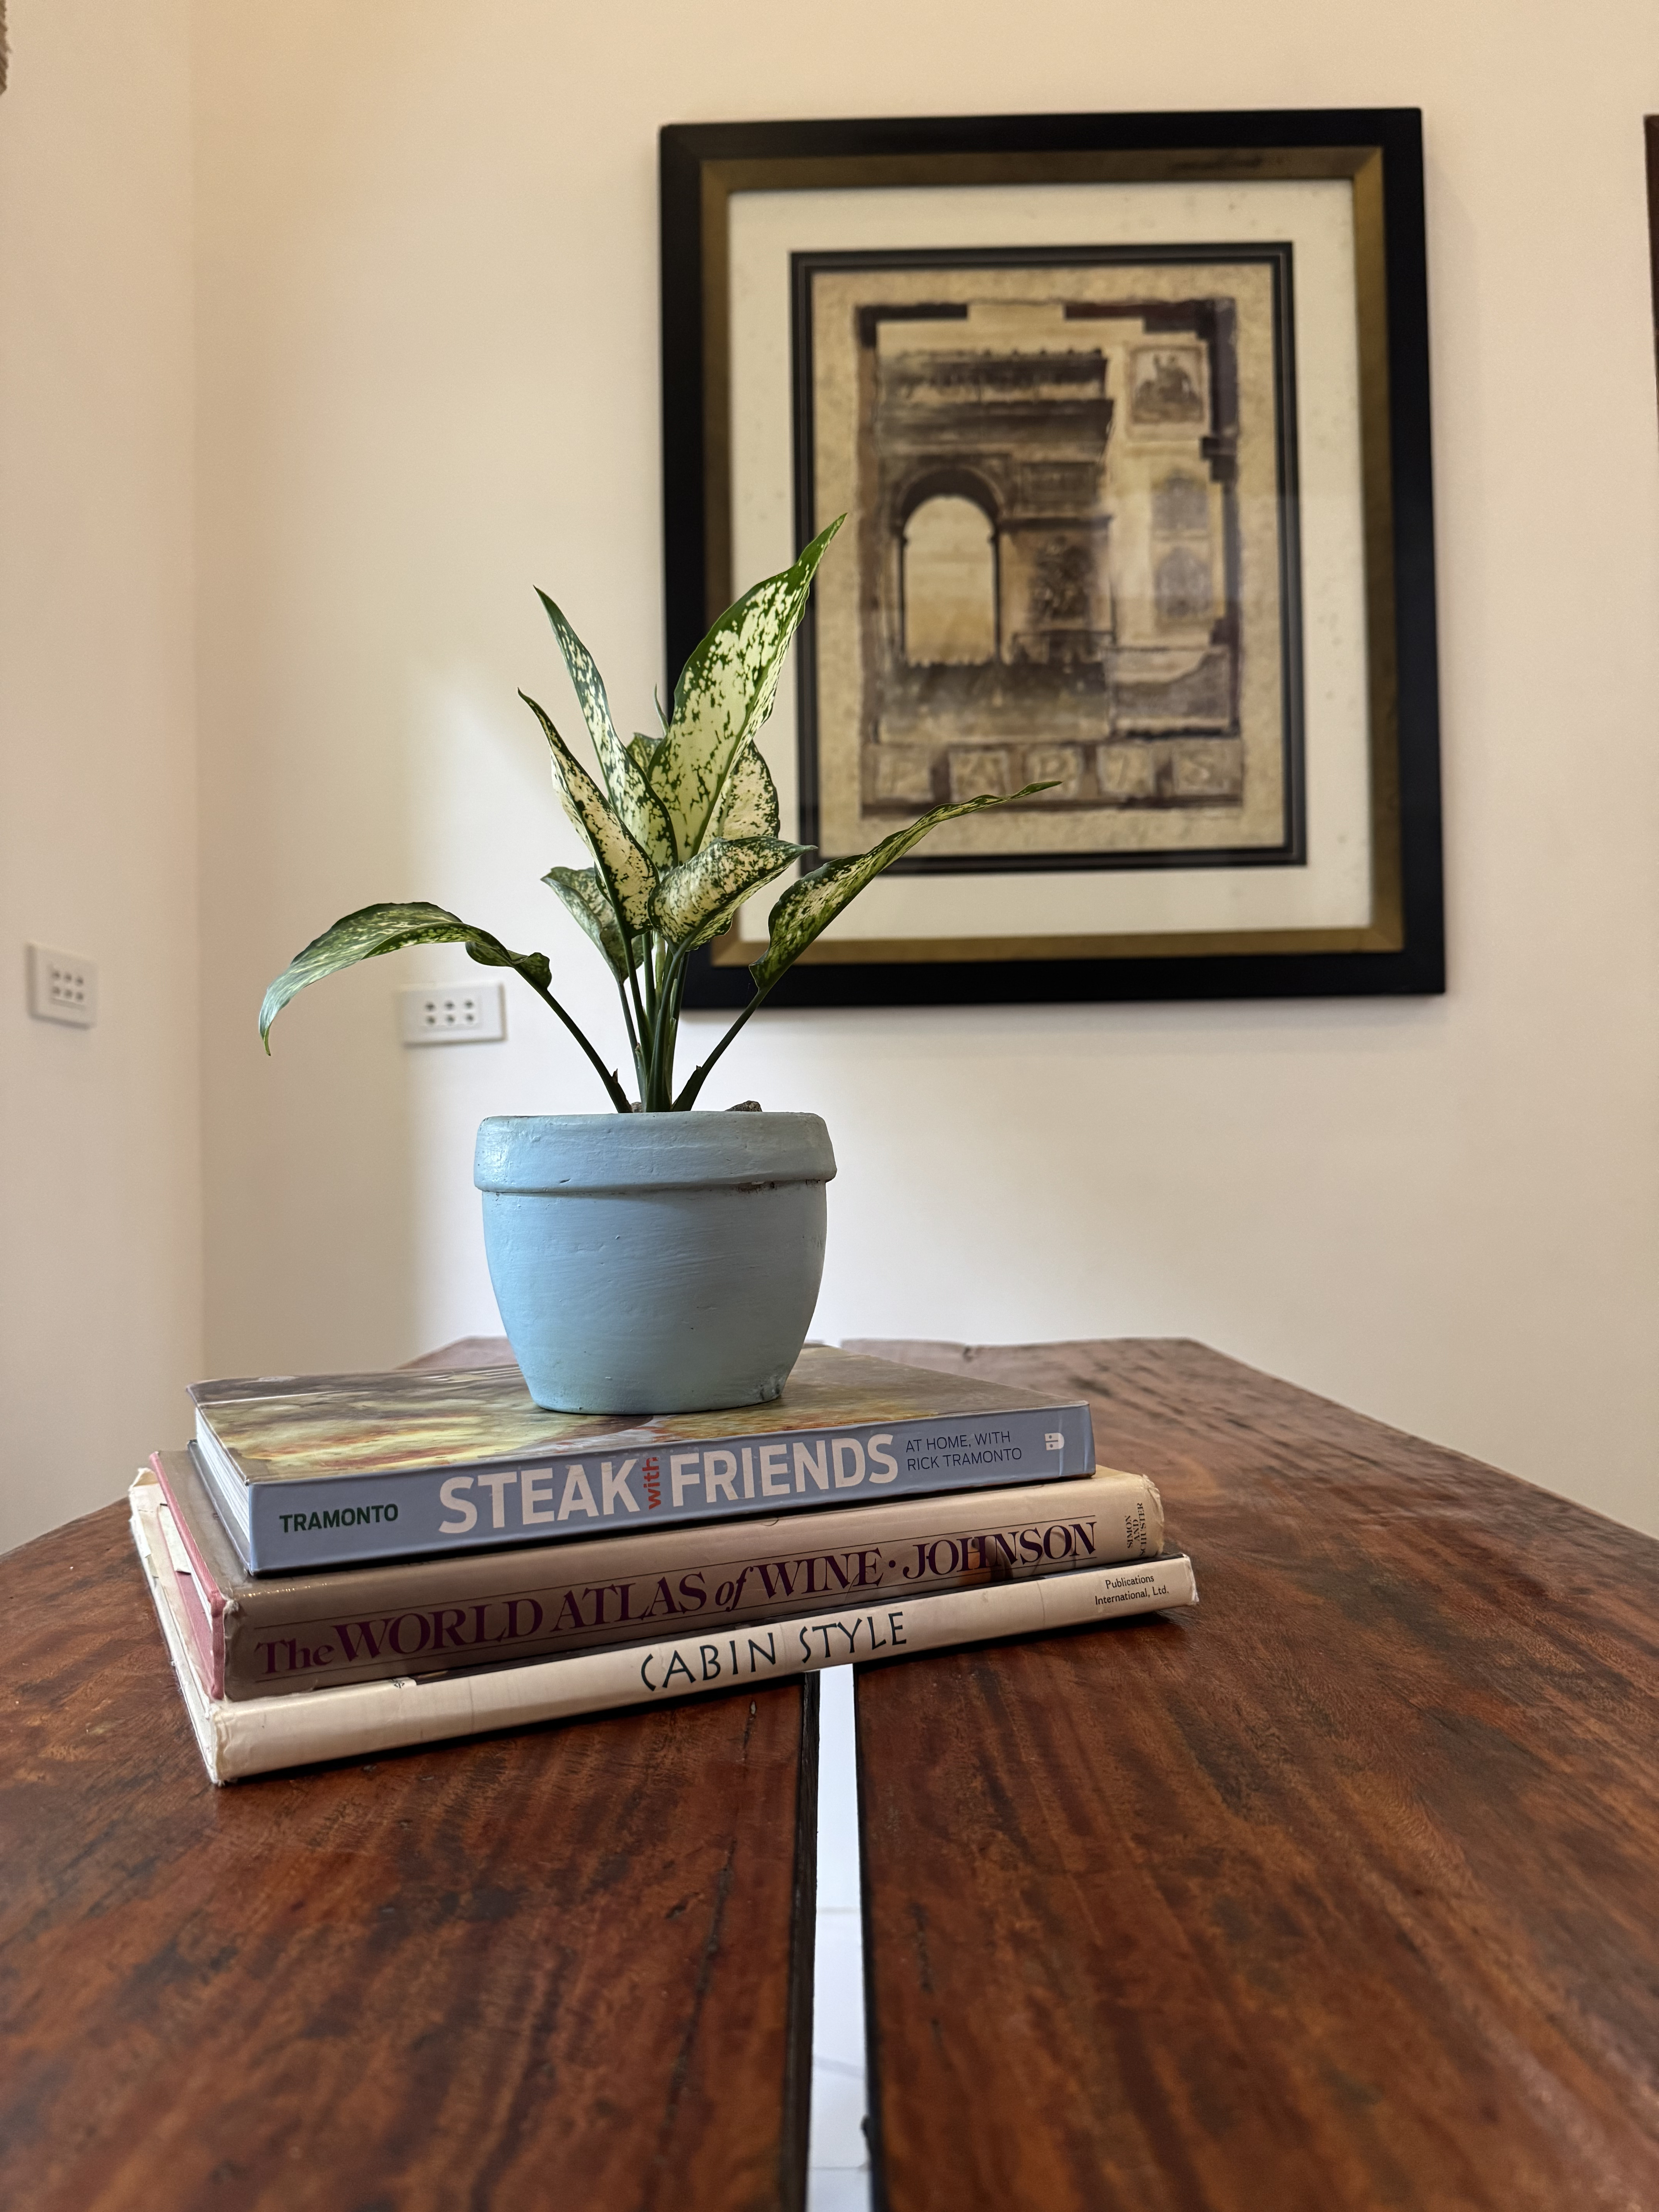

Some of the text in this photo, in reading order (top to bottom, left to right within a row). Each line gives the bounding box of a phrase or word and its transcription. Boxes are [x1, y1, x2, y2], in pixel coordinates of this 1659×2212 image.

[906, 1431, 1011, 1453] AT HOME, WITH
[907, 1448, 1022, 1471] RICK TRAMONTO
[438, 1434, 898, 1534] STEAK with FRIENDS
[279, 1503, 398, 1533] TRAMONTO
[1125, 1515, 1133, 1549] SIMON
[1095, 1585, 1169, 1605] International, Ltd.
[1105, 1575, 1154, 1589] Publications
[254, 1521, 1097, 1674] The WORLD ATLAS of WINE JOHNSON
[641, 1611, 908, 1692] CABIN STYLE
